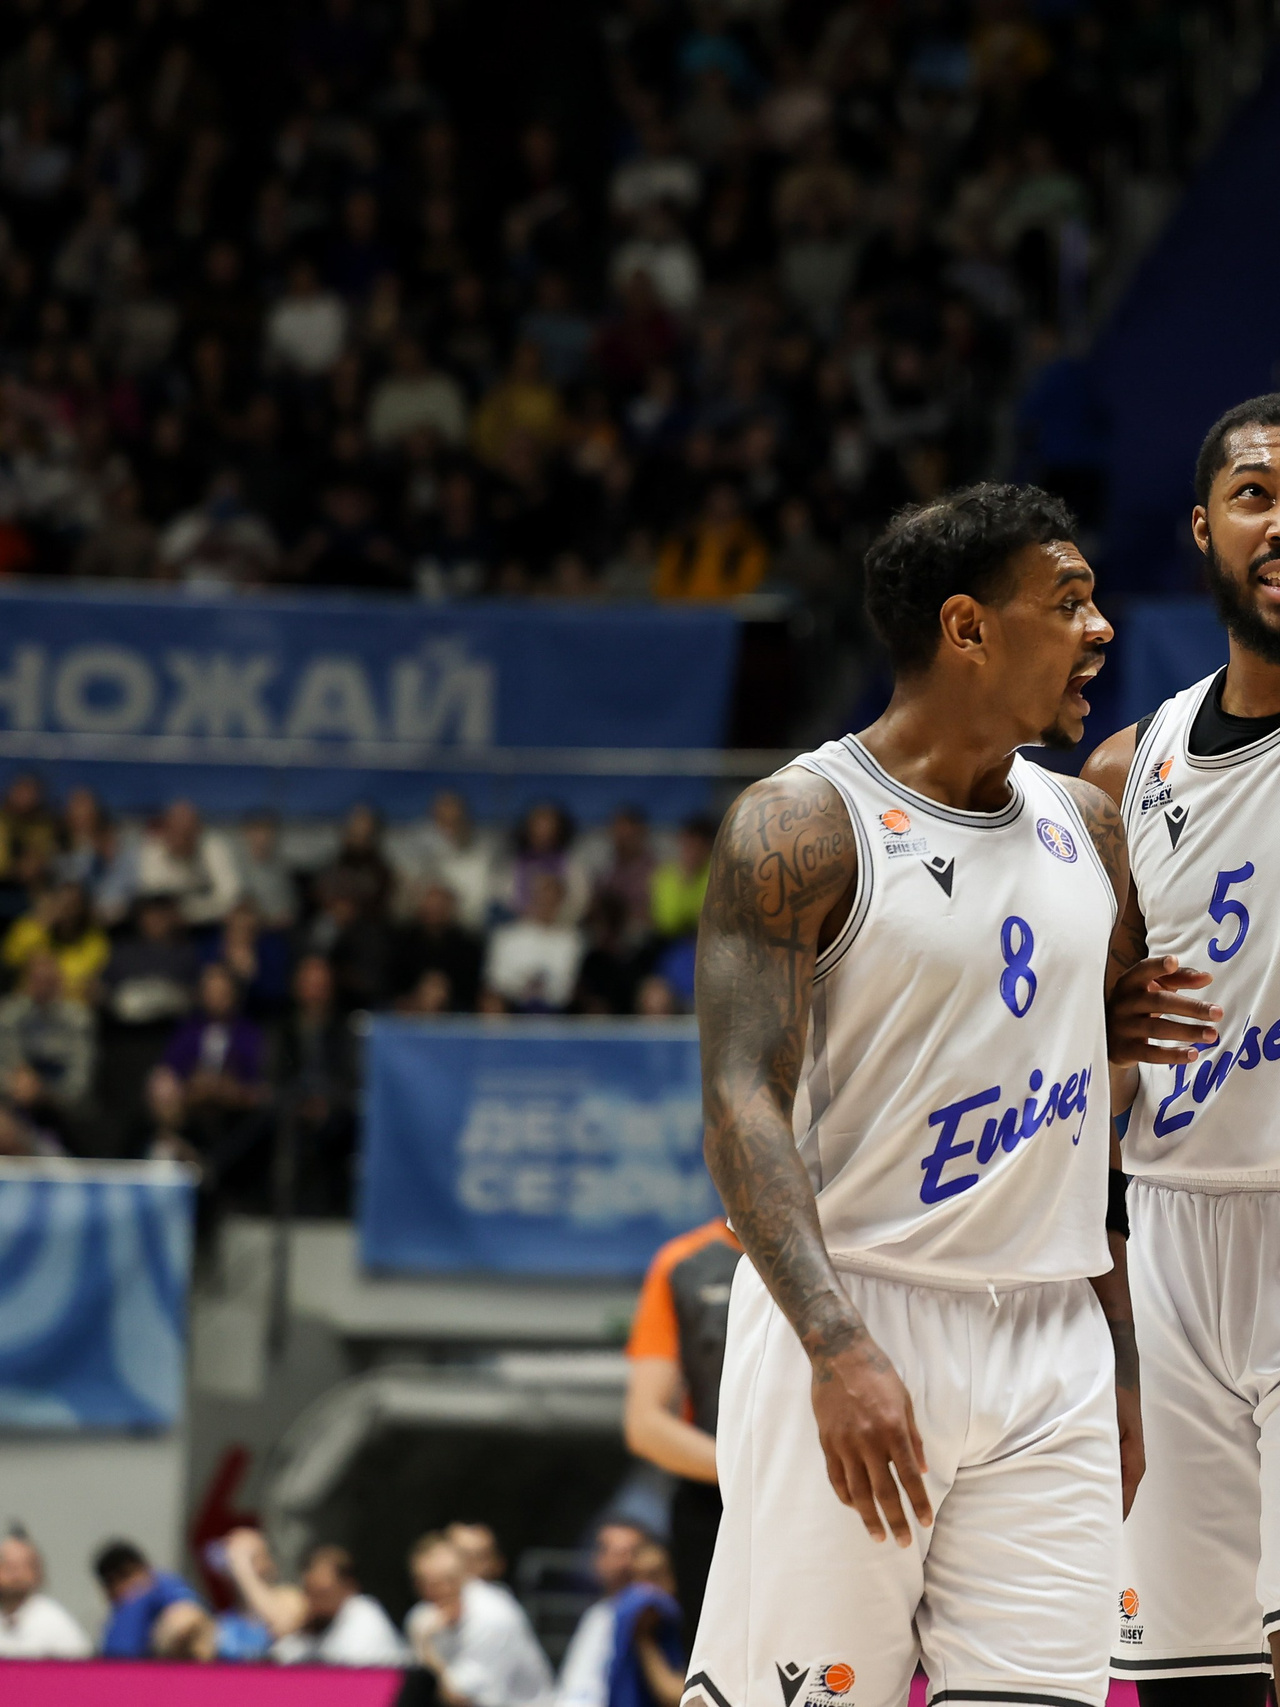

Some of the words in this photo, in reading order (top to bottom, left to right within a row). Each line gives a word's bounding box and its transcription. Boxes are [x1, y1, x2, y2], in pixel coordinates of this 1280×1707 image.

[757, 792, 830, 852] Fear
[1141, 788, 1172, 811] EEY
[758, 828, 842, 917] None
[1206, 860, 1255, 963] 5
[999, 915, 1037, 1019] 8
[919, 1062, 1093, 1205] Enisey
